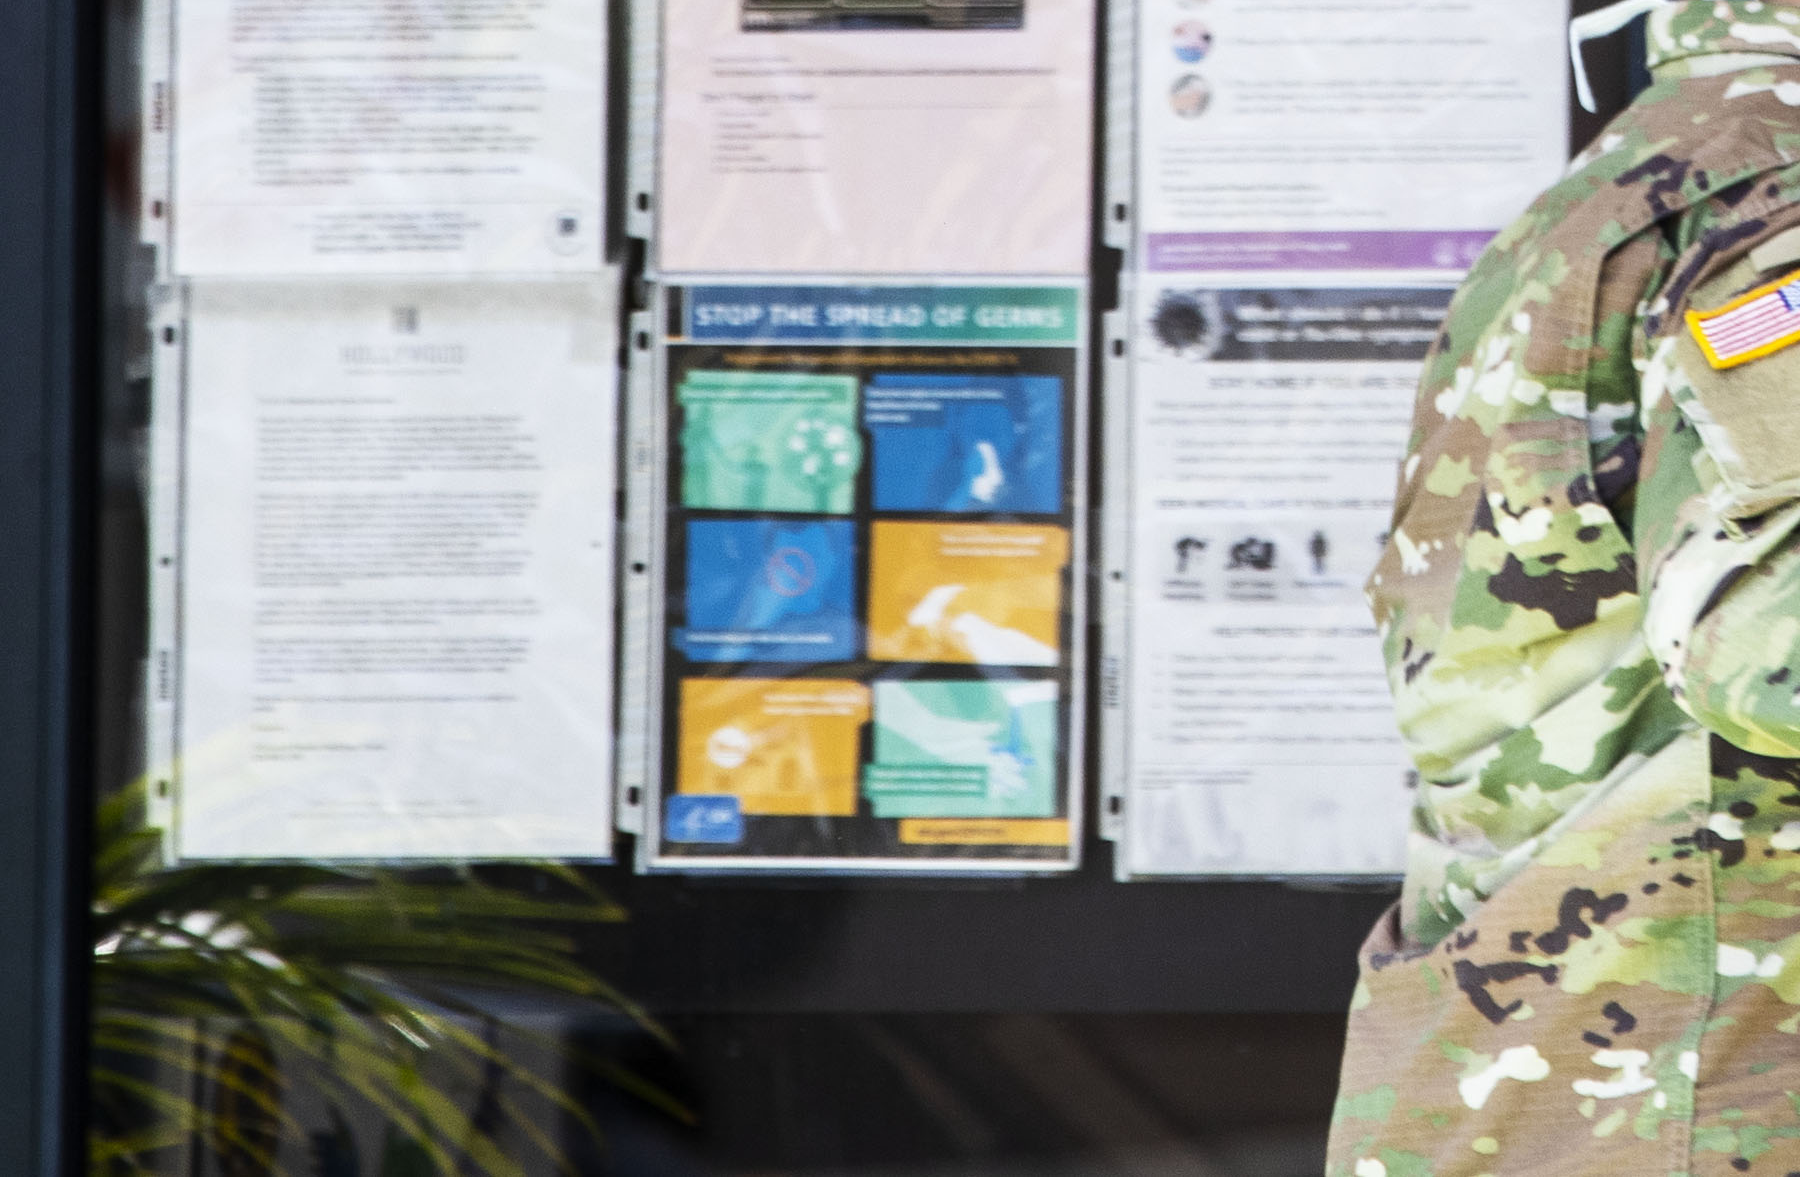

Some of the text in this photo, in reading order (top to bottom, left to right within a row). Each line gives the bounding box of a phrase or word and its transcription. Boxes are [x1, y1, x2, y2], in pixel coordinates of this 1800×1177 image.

[695, 304, 1063, 328] STOP THE SPREAD OF GERMS
